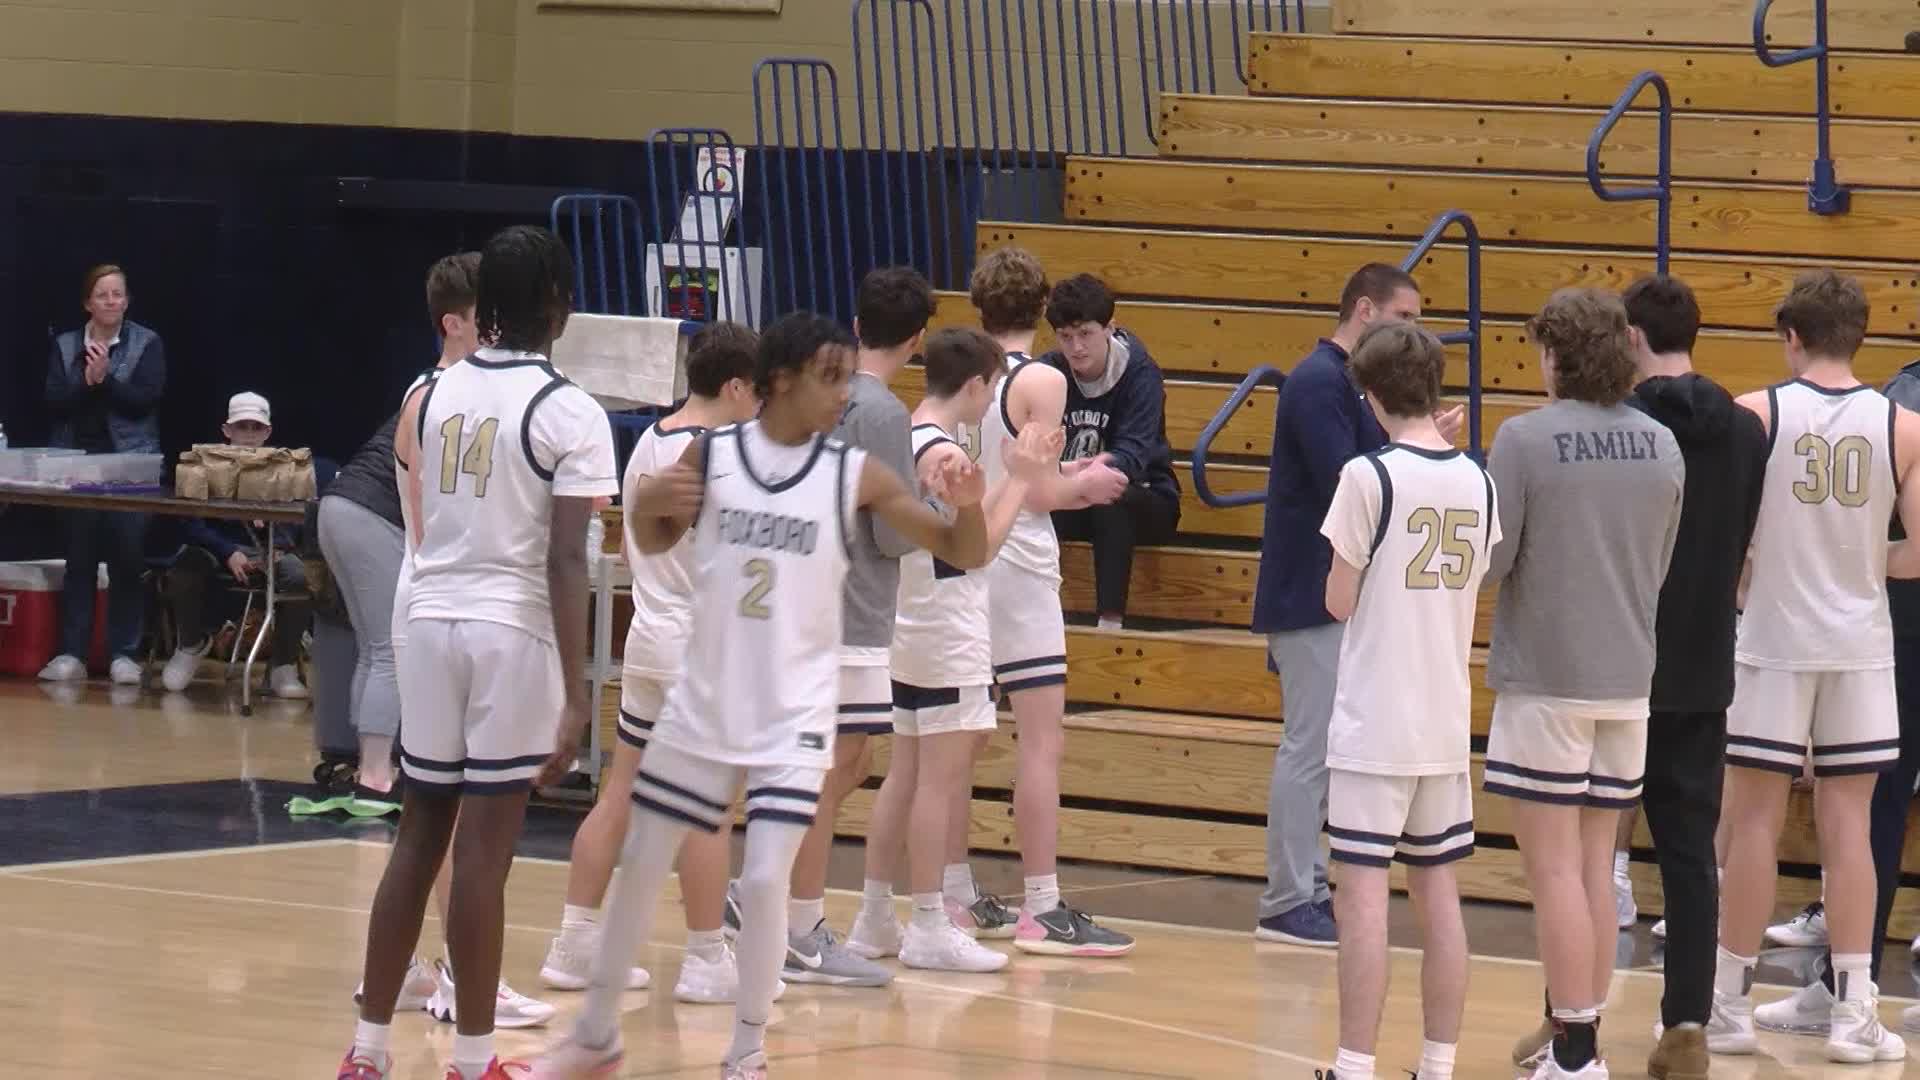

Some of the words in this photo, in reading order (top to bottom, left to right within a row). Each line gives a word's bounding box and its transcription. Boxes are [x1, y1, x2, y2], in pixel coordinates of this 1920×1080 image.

[440, 413, 499, 498] 14
[1553, 431, 1658, 463] FAMILY
[1792, 432, 1873, 508] 30
[1405, 507, 1480, 590] 25
[738, 557, 775, 620] 2
